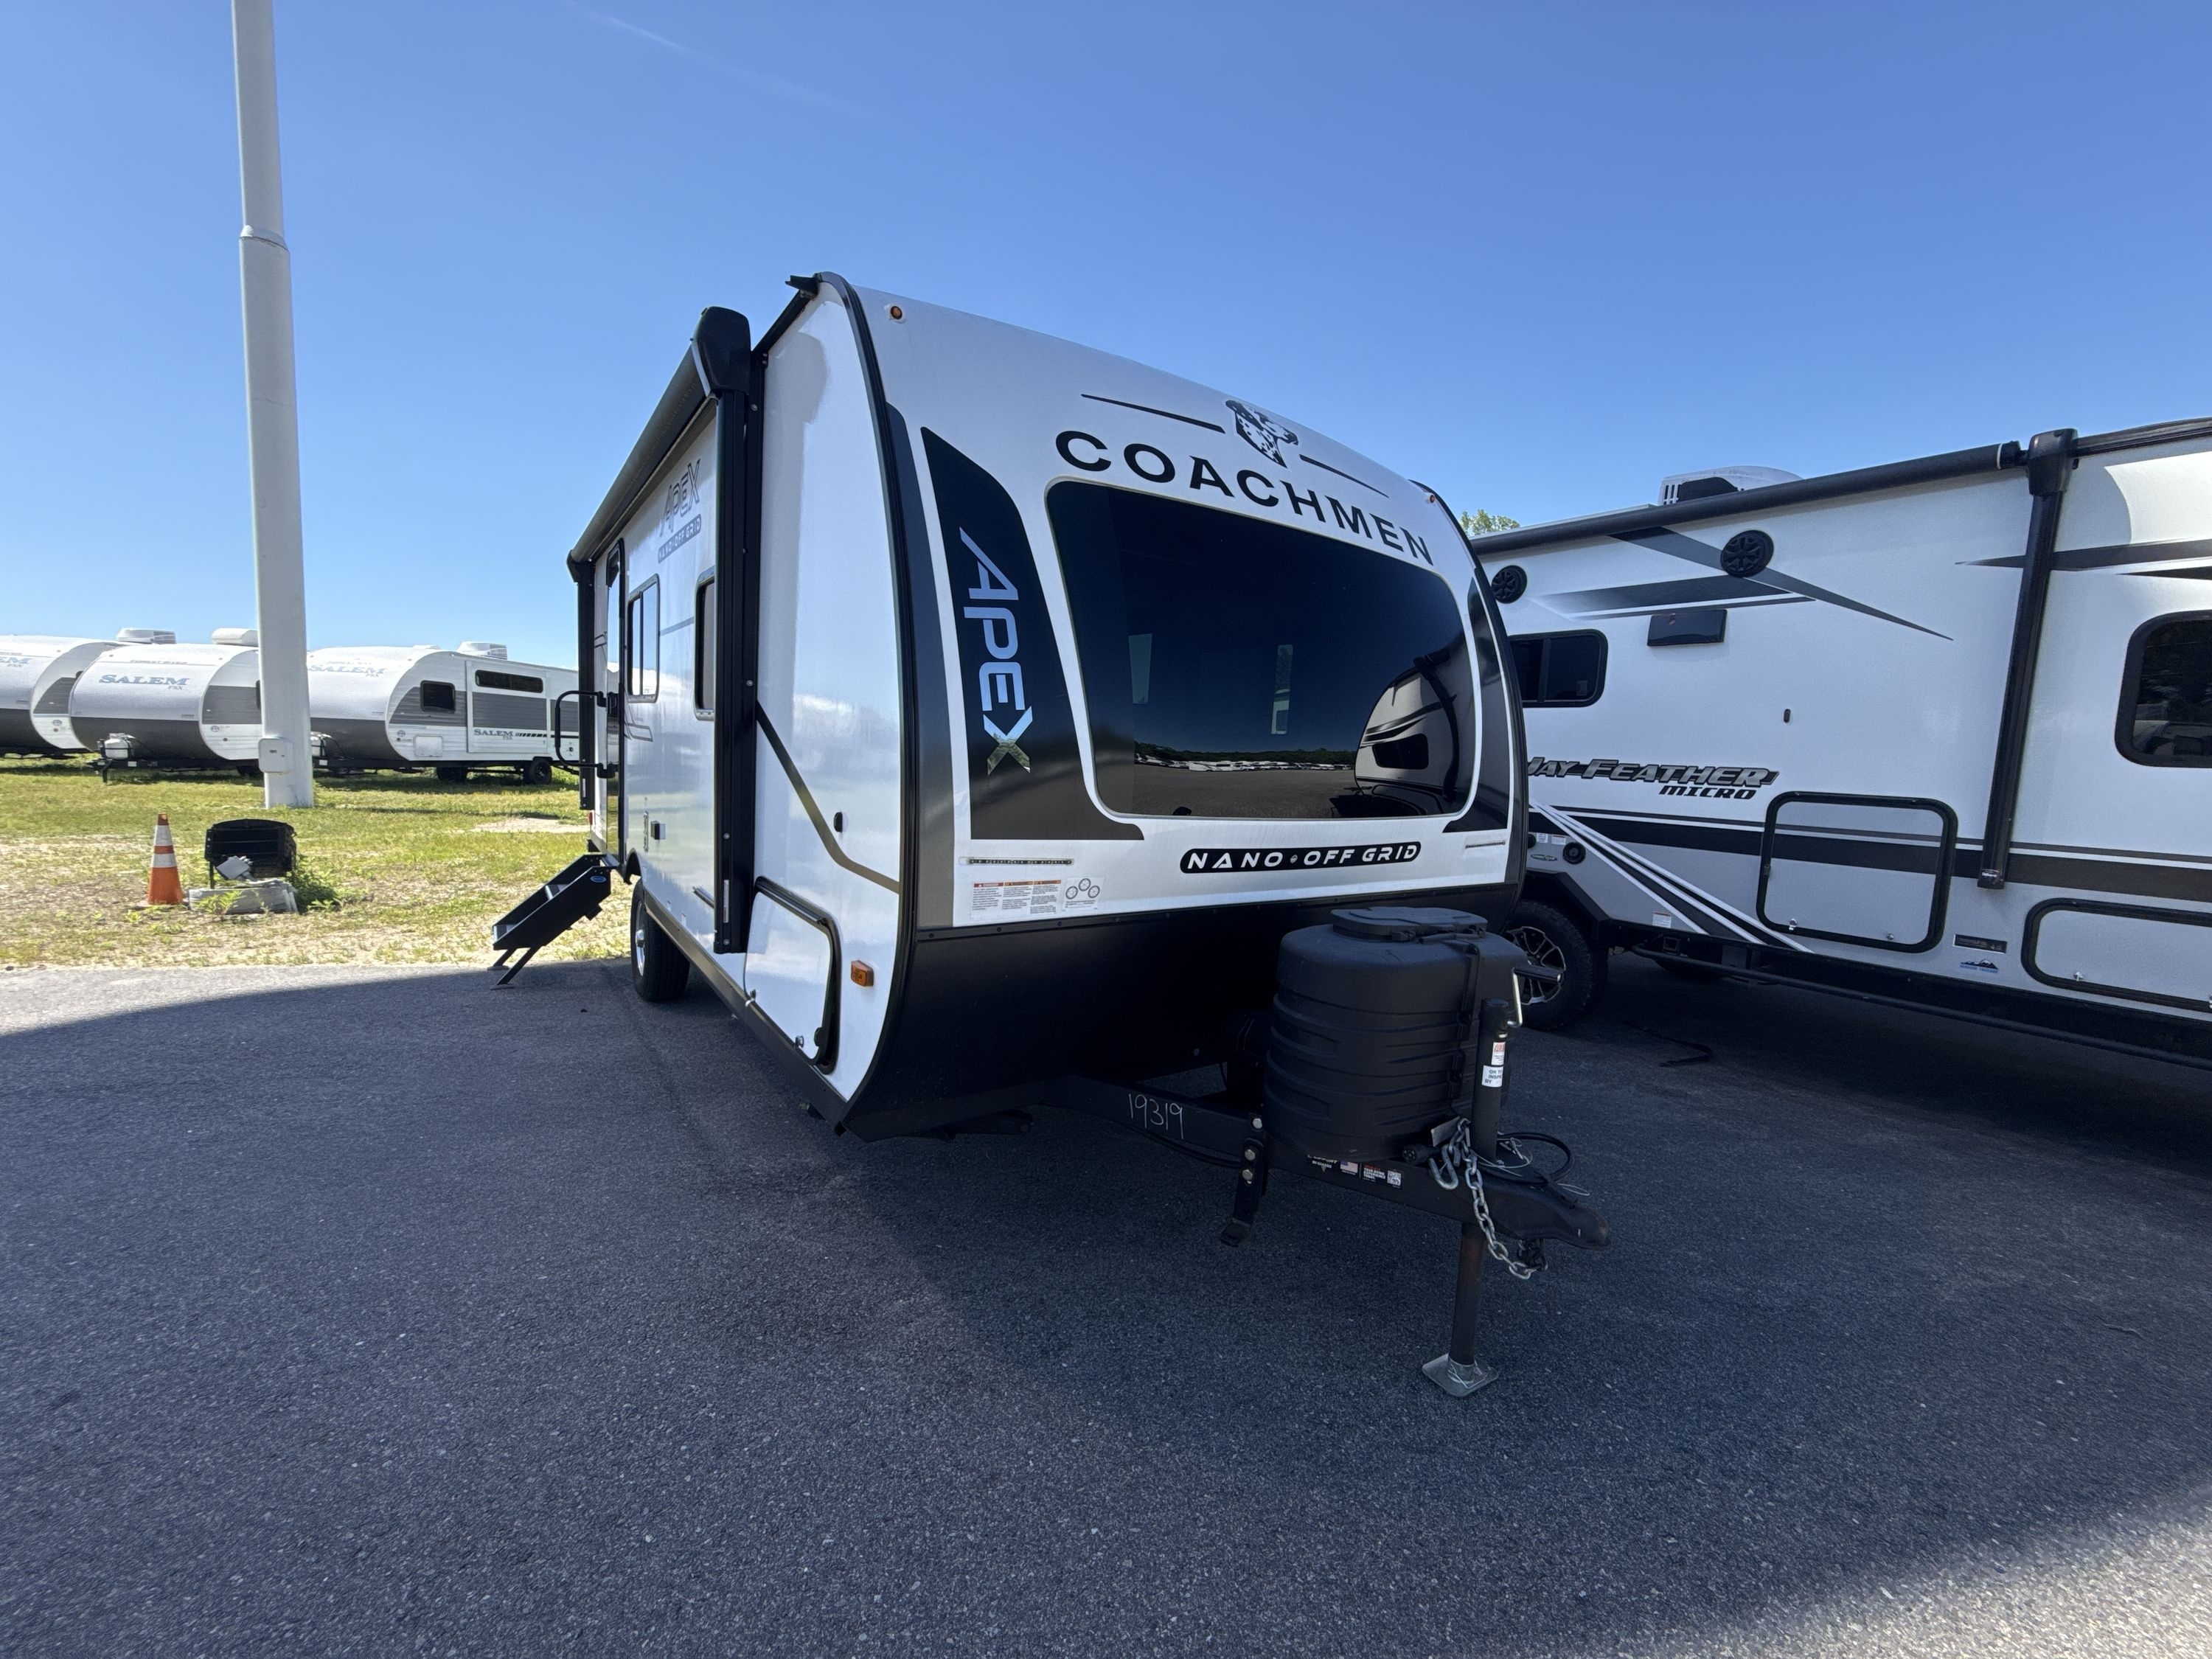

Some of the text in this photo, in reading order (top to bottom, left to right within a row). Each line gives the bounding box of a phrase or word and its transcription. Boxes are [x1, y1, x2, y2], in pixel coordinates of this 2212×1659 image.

[660, 459, 701, 538] APEX
[1055, 430, 1434, 566] COACHMEN
[674, 530, 685, 548] OFF
[686, 517, 700, 538] GRID
[959, 526, 1033, 776] APEX
[99, 674, 190, 686] SALEM
[307, 664, 388, 675] SALEM
[1528, 757, 1771, 787] JAY FEATHER
[1659, 785, 1757, 800] MICRO
[1187, 844, 1419, 869] NANO OFF GRID
[1128, 1093, 1184, 1140] 19319
